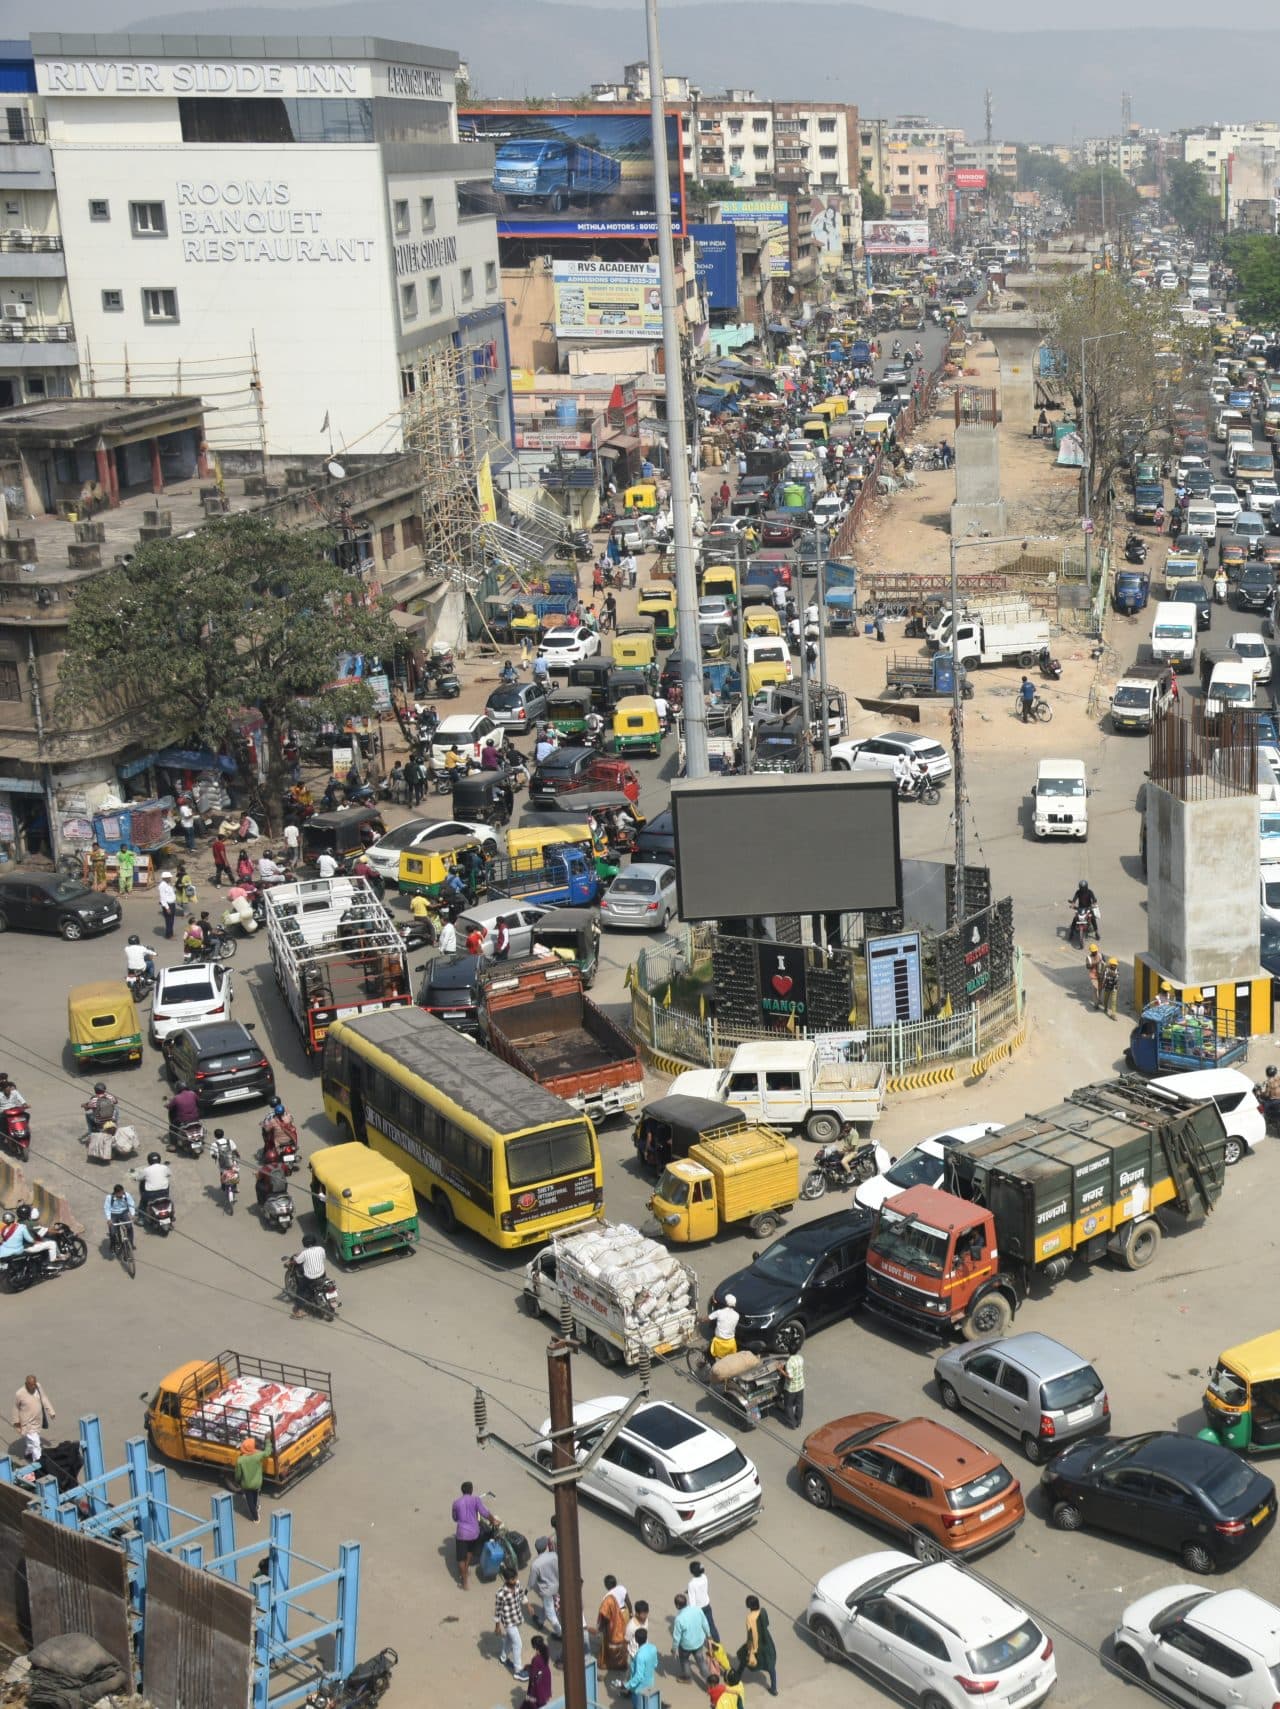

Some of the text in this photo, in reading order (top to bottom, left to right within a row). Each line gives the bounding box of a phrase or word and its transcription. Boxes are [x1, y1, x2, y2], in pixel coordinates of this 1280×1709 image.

[47, 62, 357, 93] RIVER SIDDE INN
[176, 181, 290, 205] ROOMS
[179, 210, 322, 233] BANQUET
[183, 238, 374, 262] RESTAURANT
[393, 236, 456, 275] RIVER SIDDE INN
[578, 263, 644, 272] RVS ACADEMY
[777, 955, 786, 970] I
[973, 962, 981, 975] TO
[966, 971, 990, 993] MANGO
[763, 997, 805, 1013] MANGO
[1037, 1199, 1067, 1224] मानगो
[1082, 1185, 1104, 1202] नगर
[1120, 1167, 1145, 1187] निगम
